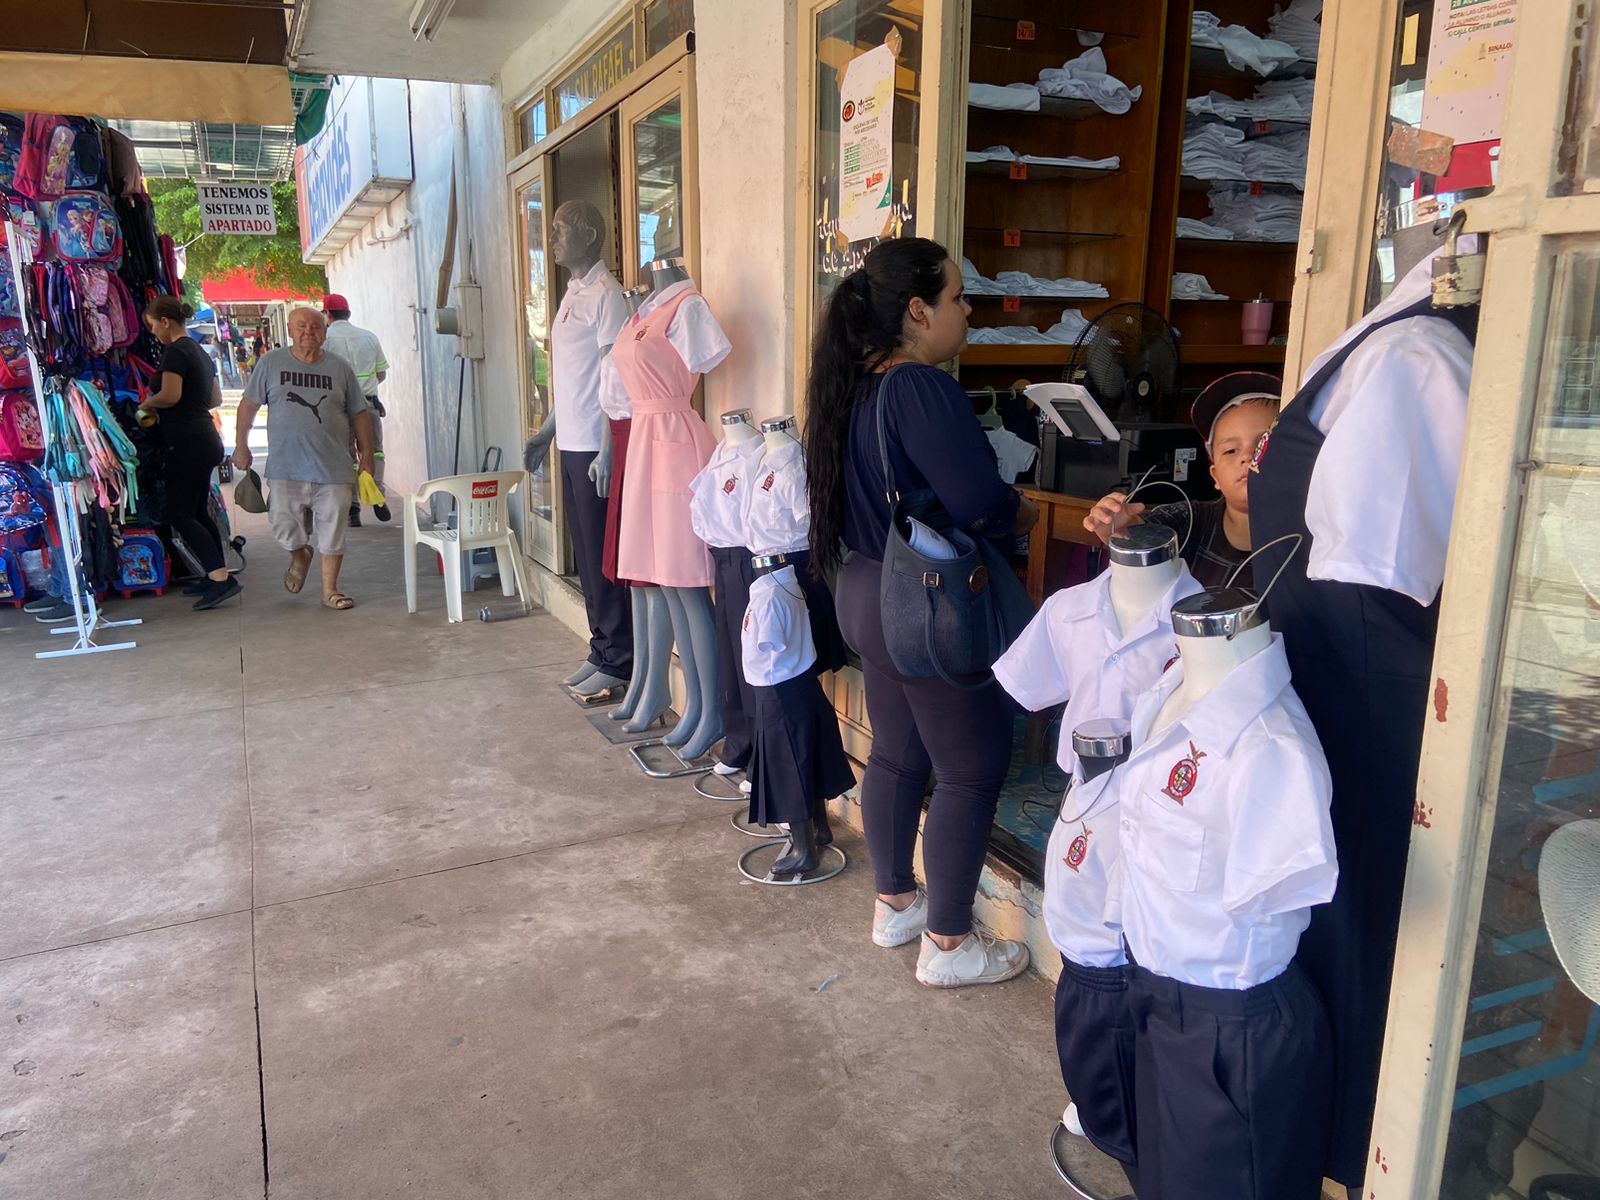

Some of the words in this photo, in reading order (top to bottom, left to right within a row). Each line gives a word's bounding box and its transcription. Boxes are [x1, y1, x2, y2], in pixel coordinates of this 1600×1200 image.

[201, 186, 268, 199] TENEMOS
[205, 203, 252, 215] SISTEMA
[256, 204, 270, 215] DE
[208, 220, 272, 231] APARTADO
[280, 371, 333, 390] PUMA
